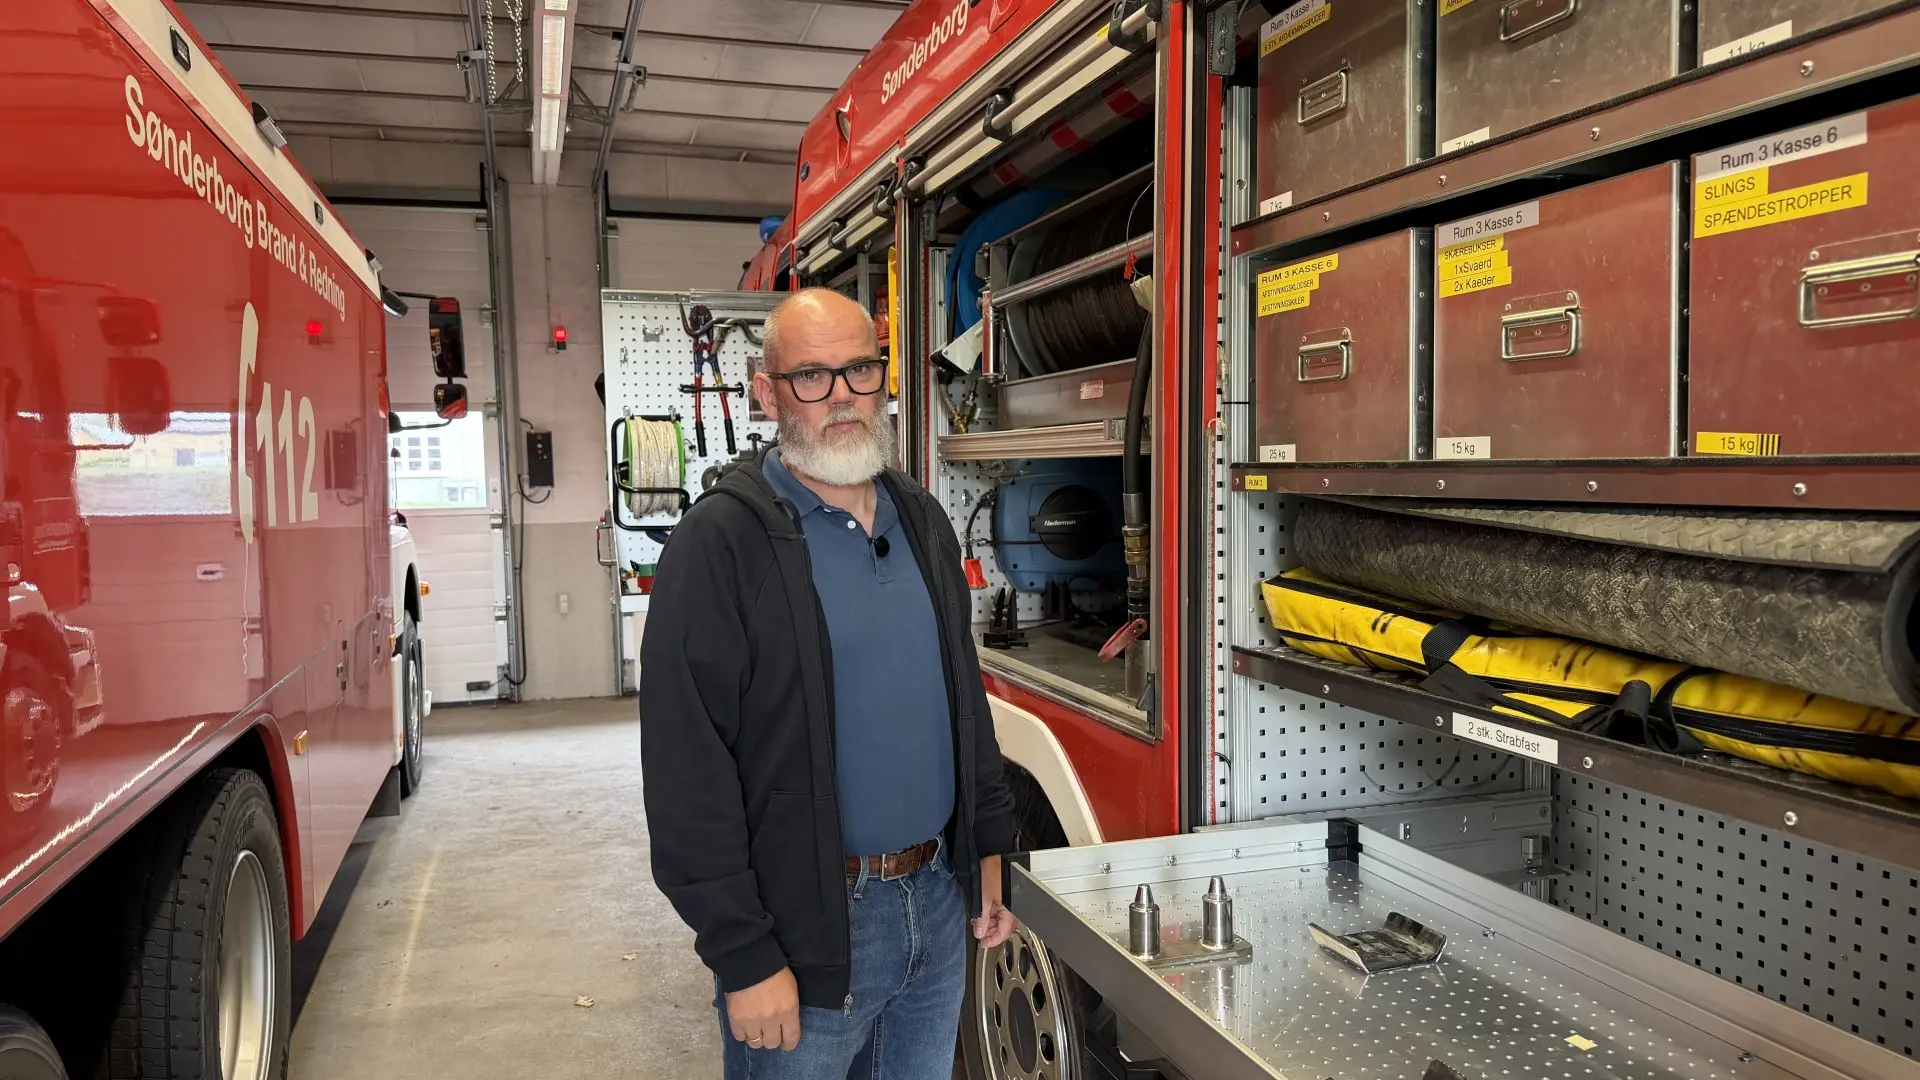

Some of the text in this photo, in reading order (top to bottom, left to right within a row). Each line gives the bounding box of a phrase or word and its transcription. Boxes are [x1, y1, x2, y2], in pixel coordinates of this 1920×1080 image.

[1270, 18, 1284, 33] Rum
[1285, 14, 1290, 24] 3
[1290, 3, 1310, 20] Kasse
[881, 0, 969, 105] Sønderborg
[1720, 126, 1838, 171] Rum 3 Kasse 6
[124, 74, 345, 322] Sønderborg Brand & Redning
[1704, 176, 1756, 201] SLINGS
[1704, 184, 1853, 229] SPÆNDESTROPPER
[1453, 210, 1523, 240] Rum 3 Kasse 5
[1444, 239, 1496, 260] SKÆREBUKSER
[1261, 259, 1333, 285] RUM 3 KASSE 6
[1455, 256, 1492, 275] 1xSvaerd
[1454, 275, 1496, 293] 2x Kaeder
[255, 382, 319, 528] 112
[1269, 448, 1286, 461] 25 kg
[1451, 441, 1475, 456] 15 kg
[1720, 436, 1755, 454] 15 kg
[1044, 519, 1076, 527] Nederman
[1468, 721, 1540, 754] 2 stk. Strabfast
